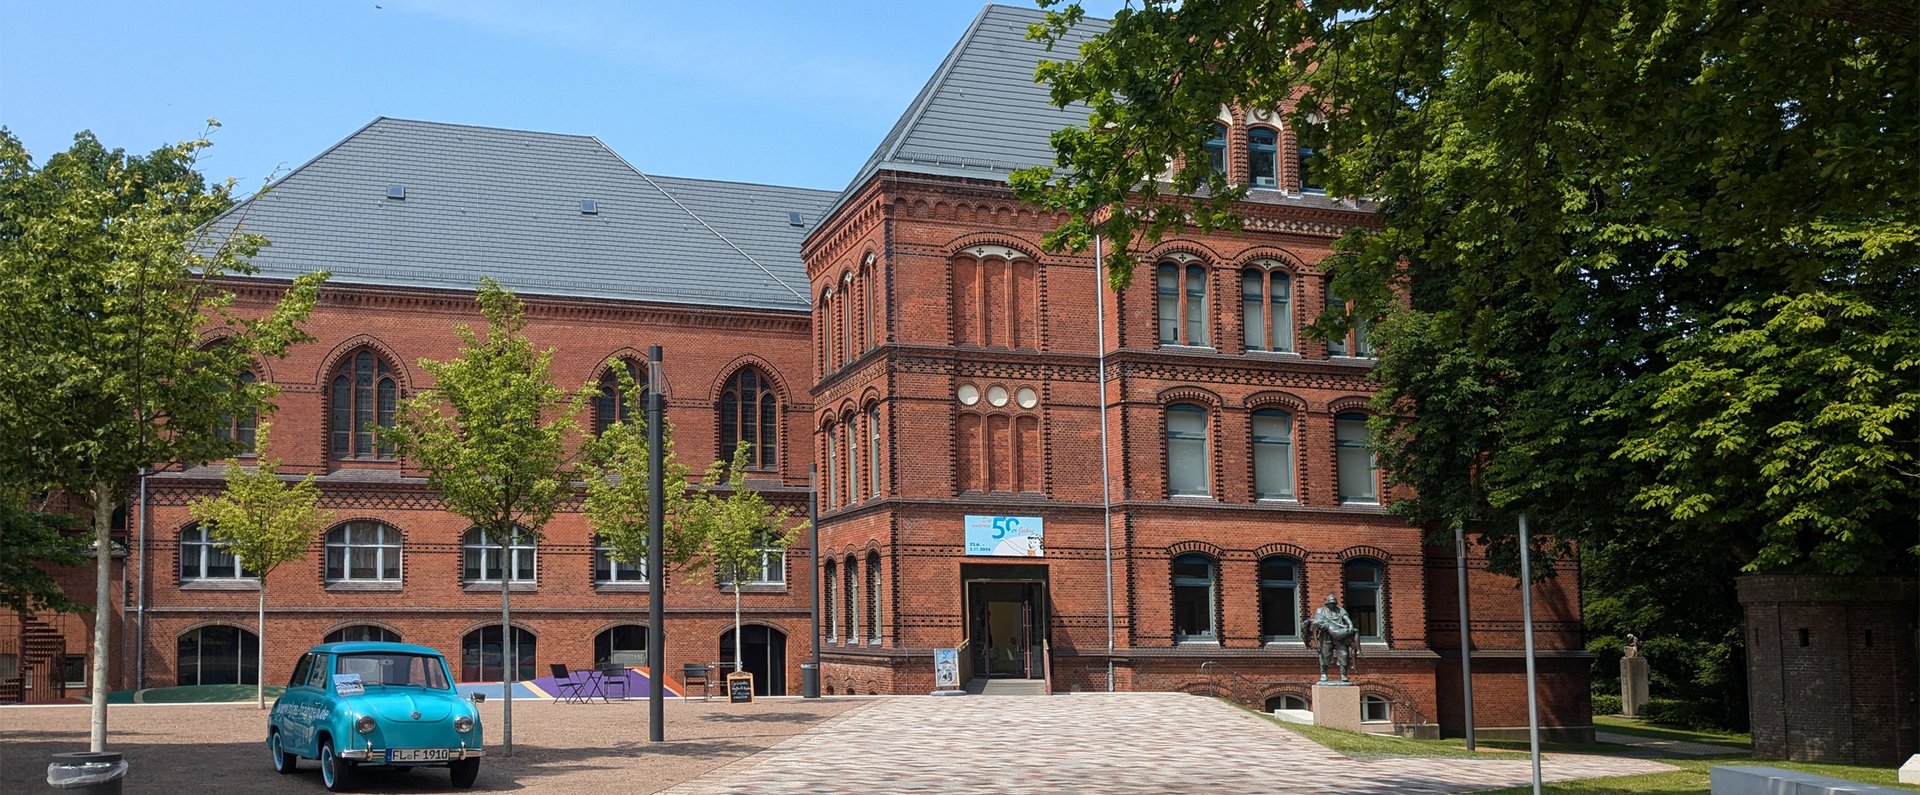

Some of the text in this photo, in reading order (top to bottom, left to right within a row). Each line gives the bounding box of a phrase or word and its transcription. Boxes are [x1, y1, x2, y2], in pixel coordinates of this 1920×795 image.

[393, 750, 448, 760] FL F 1910
